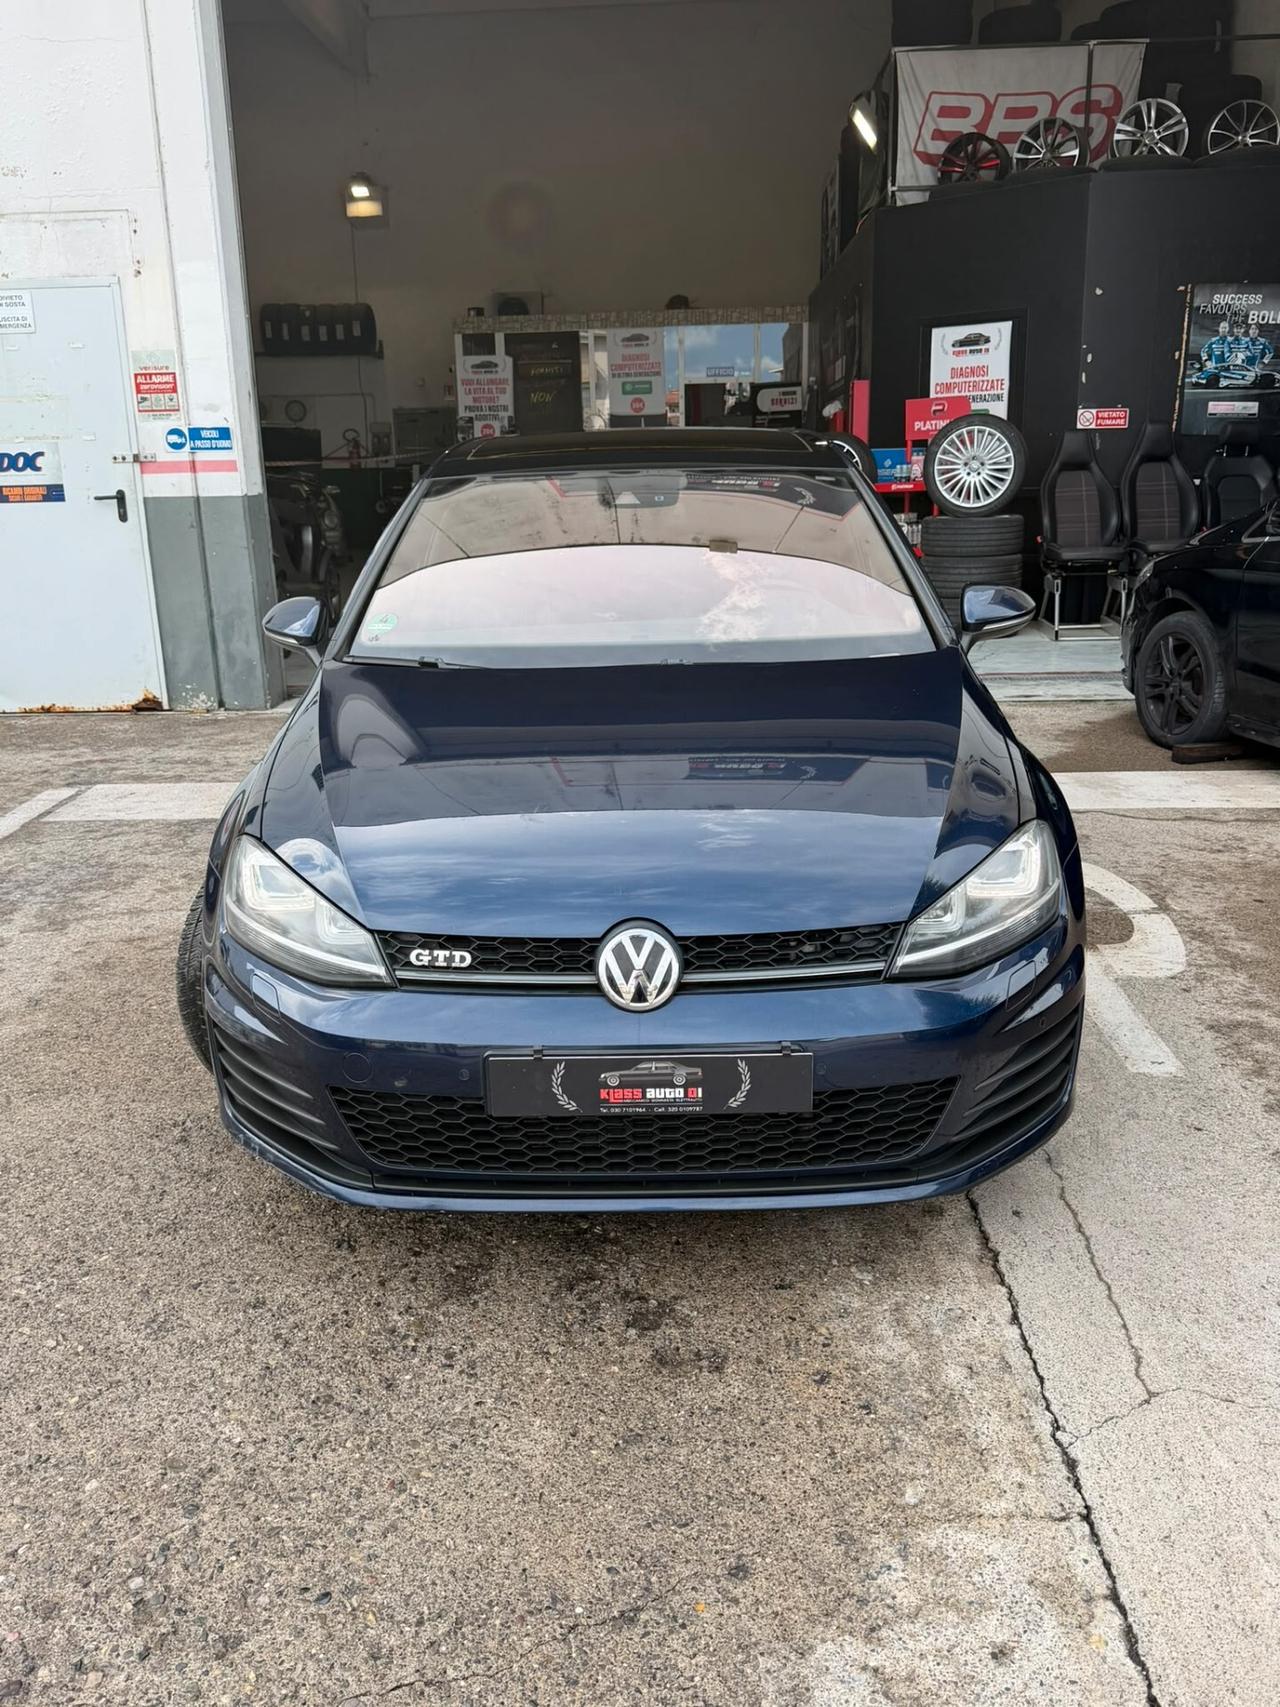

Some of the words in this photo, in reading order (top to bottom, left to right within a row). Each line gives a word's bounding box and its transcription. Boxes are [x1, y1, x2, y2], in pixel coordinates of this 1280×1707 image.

[1212, 293, 1263, 305] SUCCESS
[1199, 303, 1248, 314] FAVOURS
[1247, 310, 1280, 324] BOL
[950, 365, 989, 379] DIAGNOSI
[136, 374, 175, 384] ALLARME
[934, 379, 1005, 395] COMPUTERIZZATE
[914, 419, 954, 431] PLATIN
[200, 429, 219, 438] VEICOLI
[190, 440, 195, 449] A
[194, 440, 211, 449] PASSO
[409, 948, 473, 968] GTD
